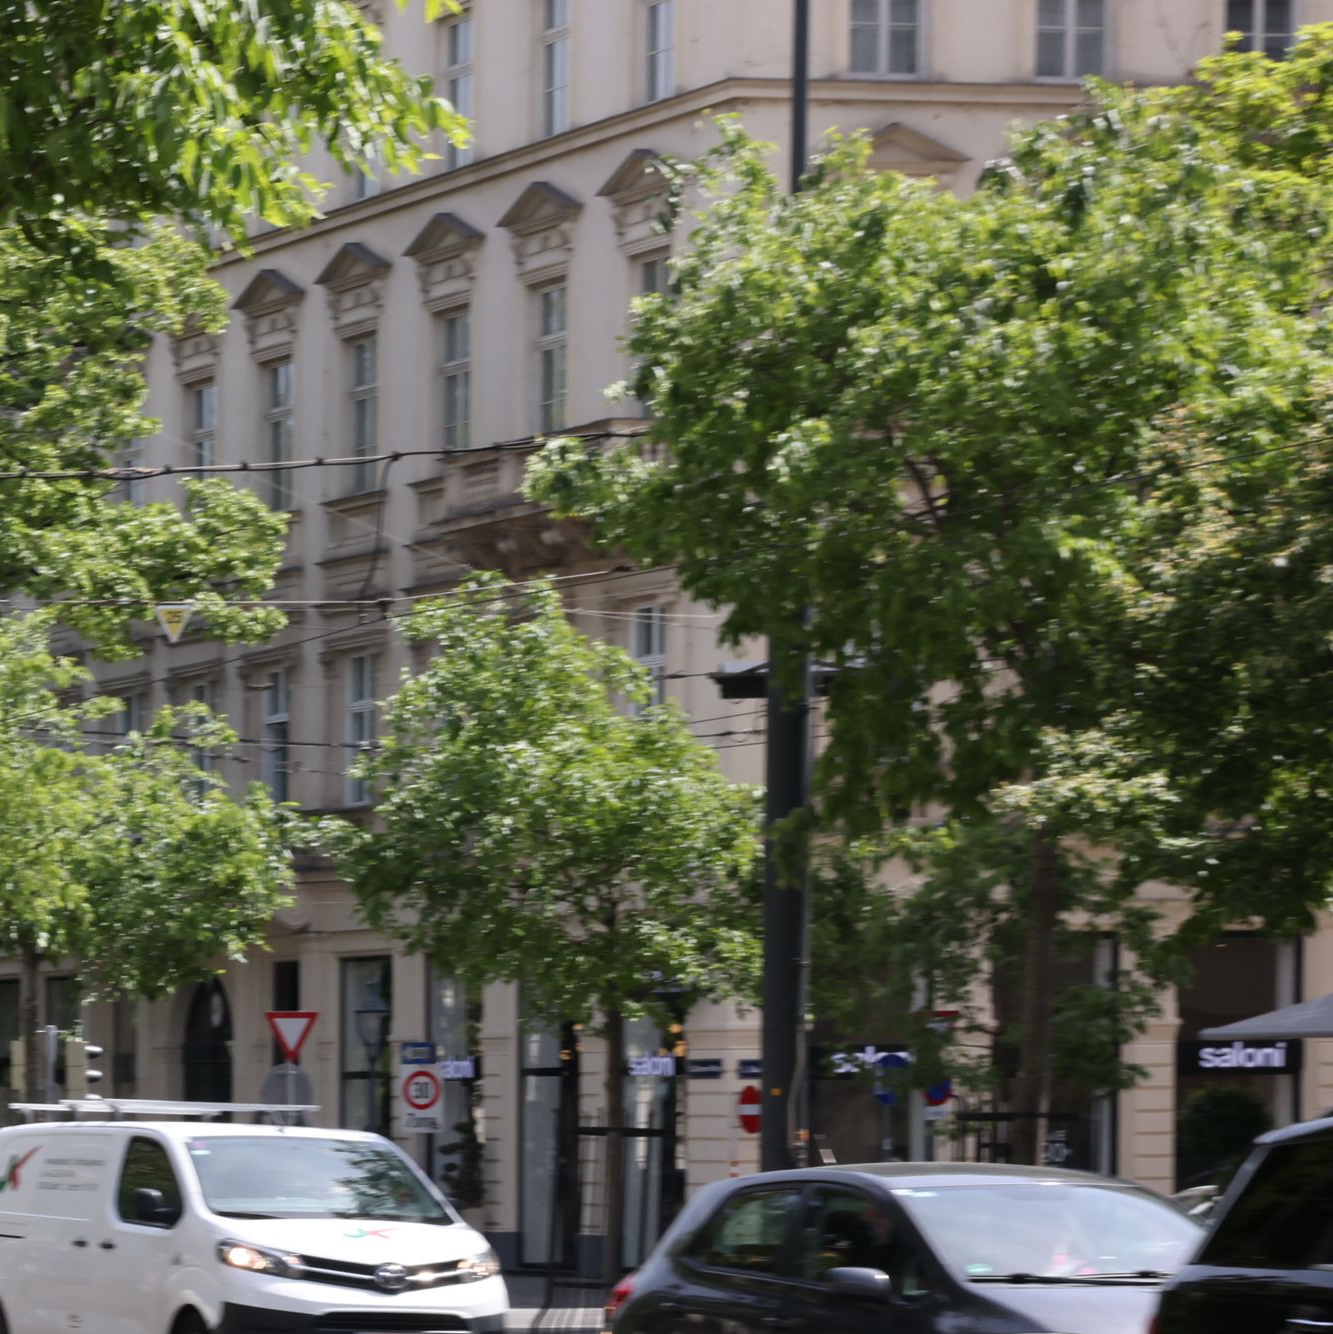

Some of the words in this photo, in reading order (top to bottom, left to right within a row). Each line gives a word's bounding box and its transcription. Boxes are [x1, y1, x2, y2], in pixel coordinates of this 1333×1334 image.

[1198, 1041, 1287, 1068] saloni
[412, 1081, 431, 1099] 30
[405, 1112, 439, 1130] Zone
